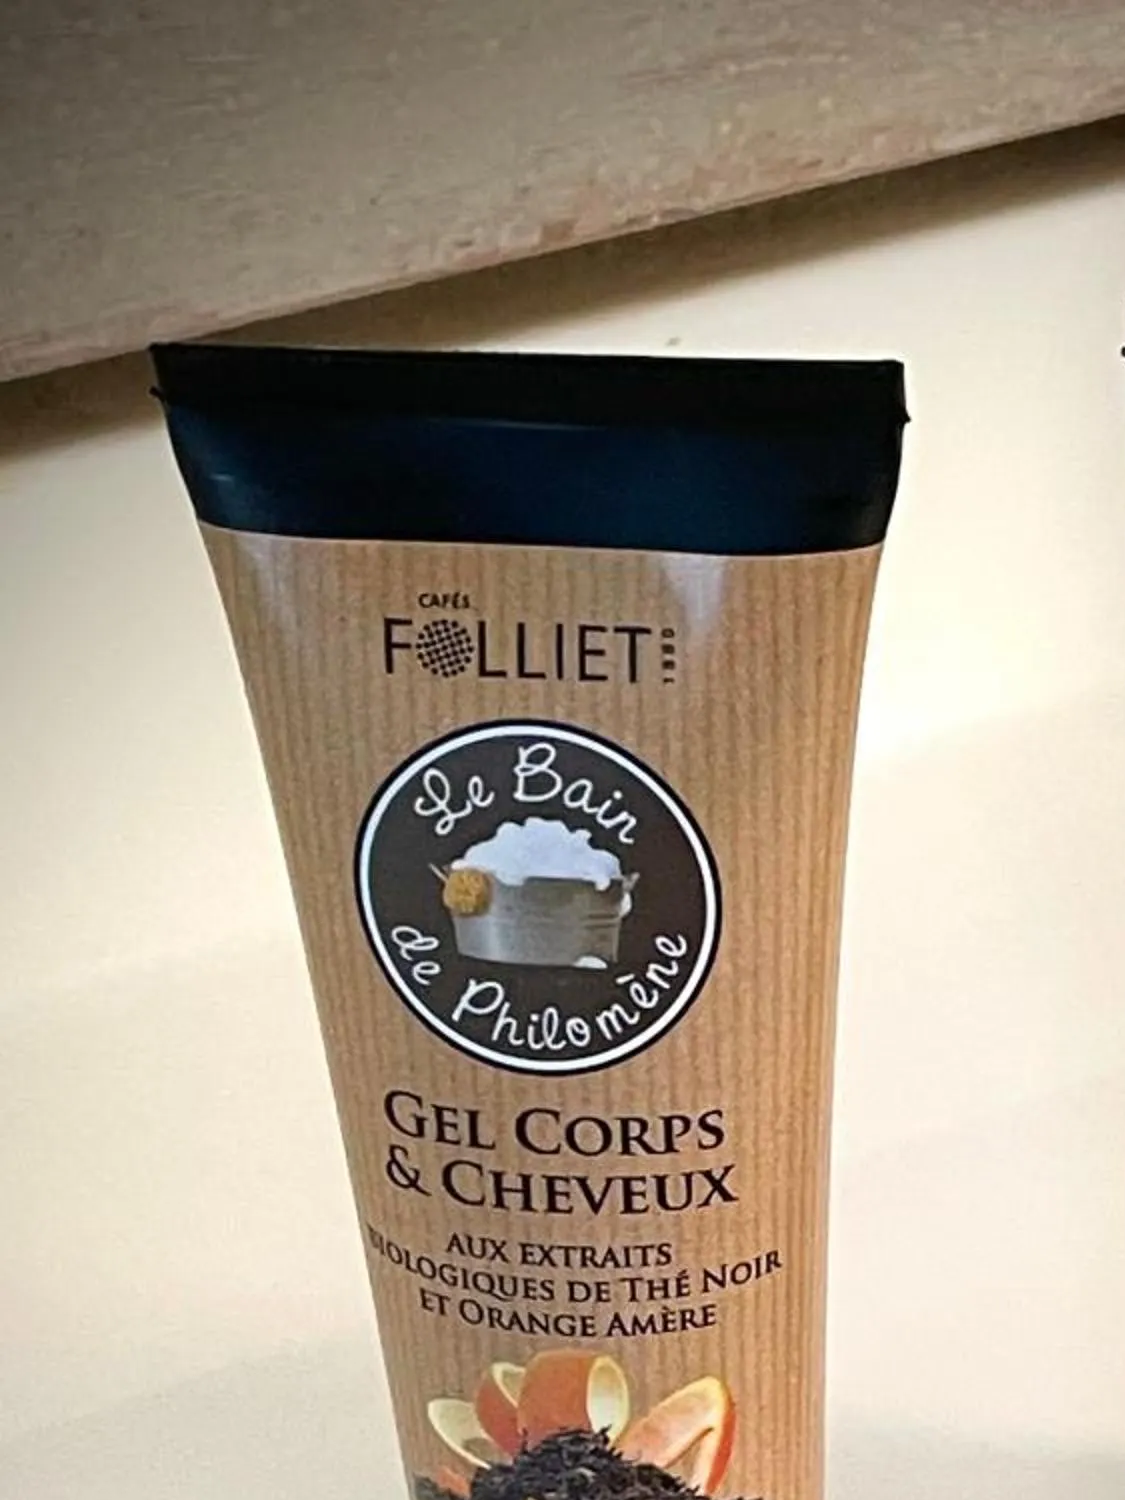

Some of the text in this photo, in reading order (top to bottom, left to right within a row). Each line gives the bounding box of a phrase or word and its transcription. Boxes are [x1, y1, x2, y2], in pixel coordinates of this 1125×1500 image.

[418, 591, 470, 609] CAFÉS
[415, 742, 635, 844] Le Bain
[391, 926, 687, 1051] de Philomène
[384, 1090, 725, 1157] GEL CORPS
[386, 1145, 739, 1216] & CHEVEUX
[446, 1232, 673, 1270] AUX EXTRAITS
[568, 1280, 611, 1303] DE
[620, 1270, 690, 1302] THÉ
[701, 1249, 783, 1294] NOIR
[419, 1288, 717, 1338] ET ORANGE AMÈRE
